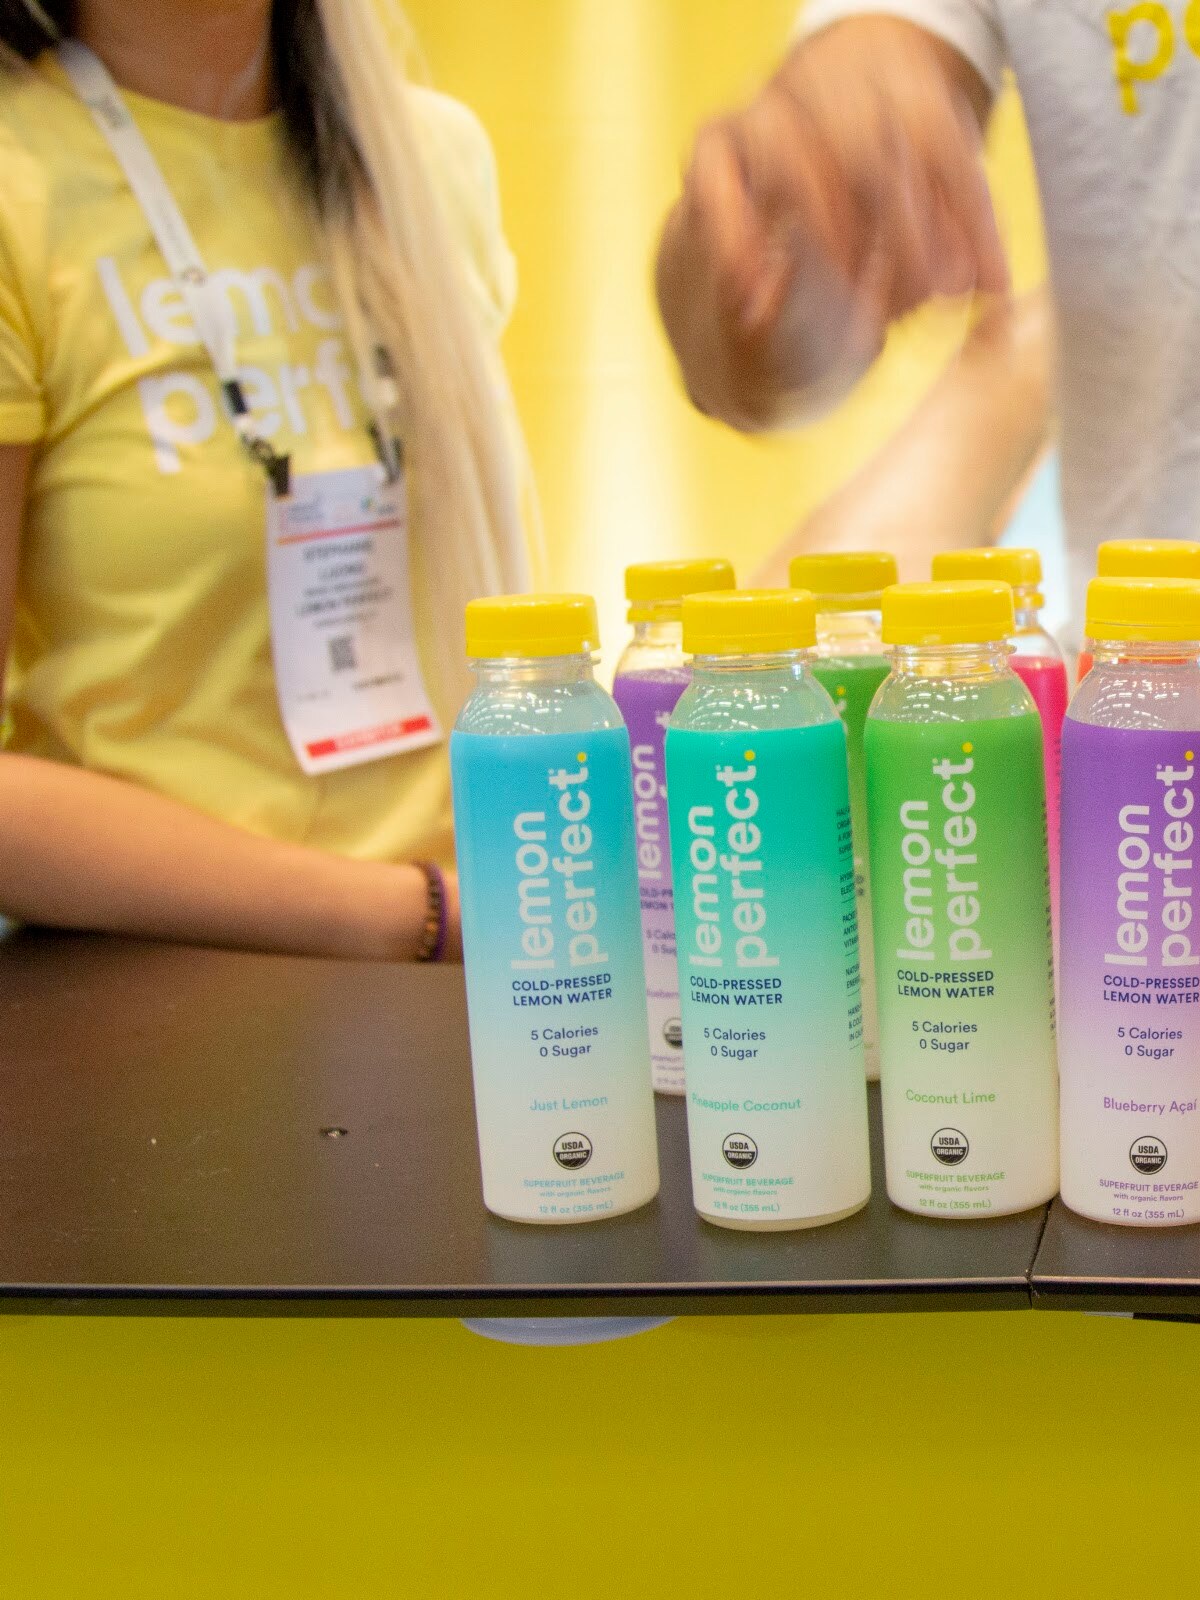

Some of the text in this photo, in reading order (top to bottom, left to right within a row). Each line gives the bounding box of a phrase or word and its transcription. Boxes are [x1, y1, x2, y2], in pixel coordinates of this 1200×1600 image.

[96, 256, 342, 358] lemo
[632, 745, 662, 879] lemon
[688, 805, 723, 967] lemon
[897, 801, 935, 960] lemon
[1104, 804, 1150, 967] lemon
[511, 811, 555, 969] lemon
[512, 973, 611, 991] COLD-PRESSED
[690, 976, 781, 990] COLD-PRESSED
[897, 970, 993, 983] COLD-PRESSED
[1103, 974, 1200, 989] COLD-PRESSED
[513, 988, 612, 1006] LEMON WATER
[898, 985, 994, 998] LEMON WATER
[1103, 990, 1200, 1004] LEMON WATER
[691, 992, 729, 1005] LEMON
[734, 994, 782, 1005] WATER
[531, 1026, 598, 1040] 5 Calories
[912, 1021, 977, 1033] 5 Calories
[1118, 1027, 1182, 1040] 5 Calories
[704, 1028, 766, 1041] 5 Calories
[540, 1044, 591, 1058] 0 Sugar
[920, 1039, 969, 1052] 0 Sugar
[1125, 1045, 1174, 1059] 0 Sugar
[710, 1046, 758, 1060] 0 Sugar
[906, 1089, 995, 1104] Coconut Lime
[530, 1097, 608, 1111] Just Lemon
[744, 1098, 800, 1111] Coconut
[1103, 1097, 1164, 1115] Blueberry
[562, 1142, 583, 1150] USDA
[729, 1142, 749, 1150] USDA
[939, 1137, 960, 1145] USDA
[560, 1152, 587, 1160] ORGANIC
[1138, 1145, 1159, 1154] USDA
[1135, 1156, 1162, 1164] ORGANIC
[906, 1170, 1005, 1182] SUPERFRUIT BEVERAGE
[1100, 1179, 1199, 1192] SUPERFRUIT BEVERAGE
[1114, 1192, 1129, 1200] with
[1131, 1194, 1157, 1202] organic
[1113, 1208, 1120, 1216] 12
[1122, 1208, 1129, 1216] fl
[1144, 1208, 1164, 1219] (355
[1167, 1208, 1184, 1219] mL)
